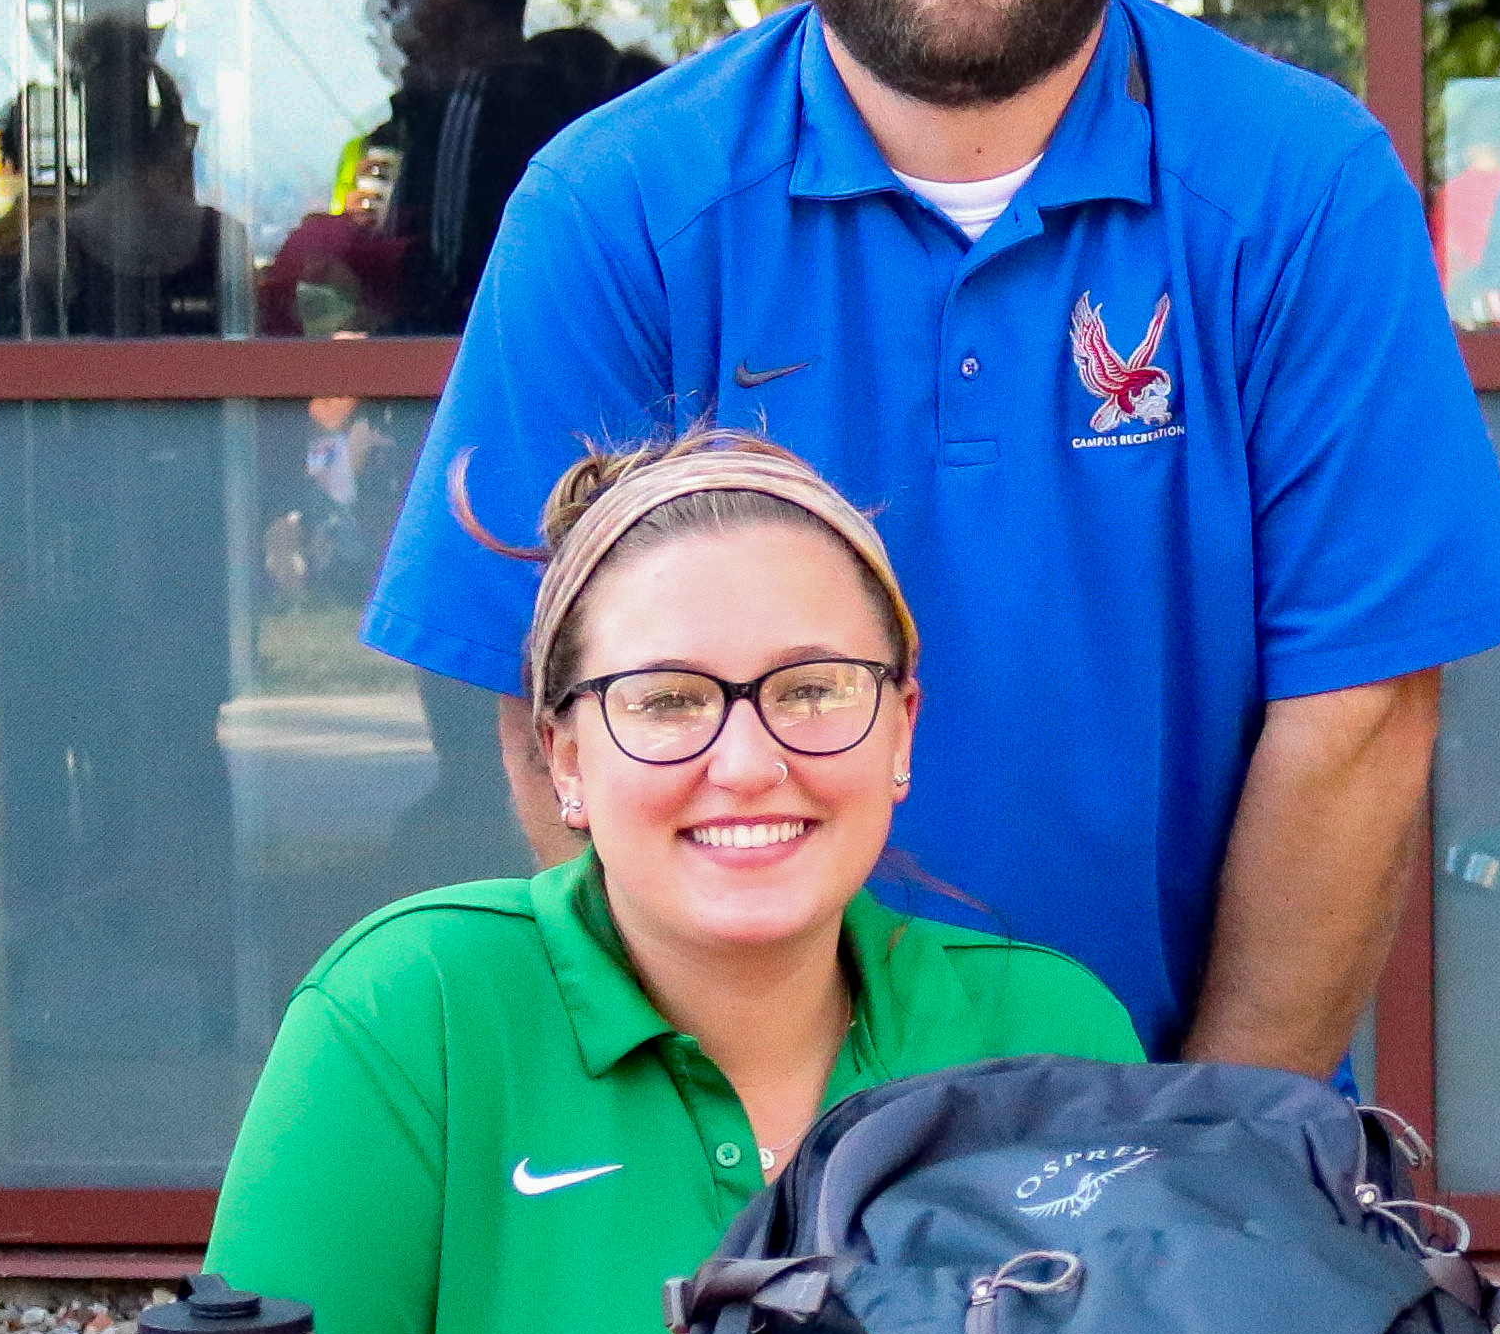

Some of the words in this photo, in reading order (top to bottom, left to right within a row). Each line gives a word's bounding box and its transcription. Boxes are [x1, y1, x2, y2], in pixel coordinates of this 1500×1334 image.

[1072, 435, 1117, 449] CAMPUS
[1119, 426, 1185, 445] RECREATION
[1016, 1145, 1158, 1199] OSPREY
